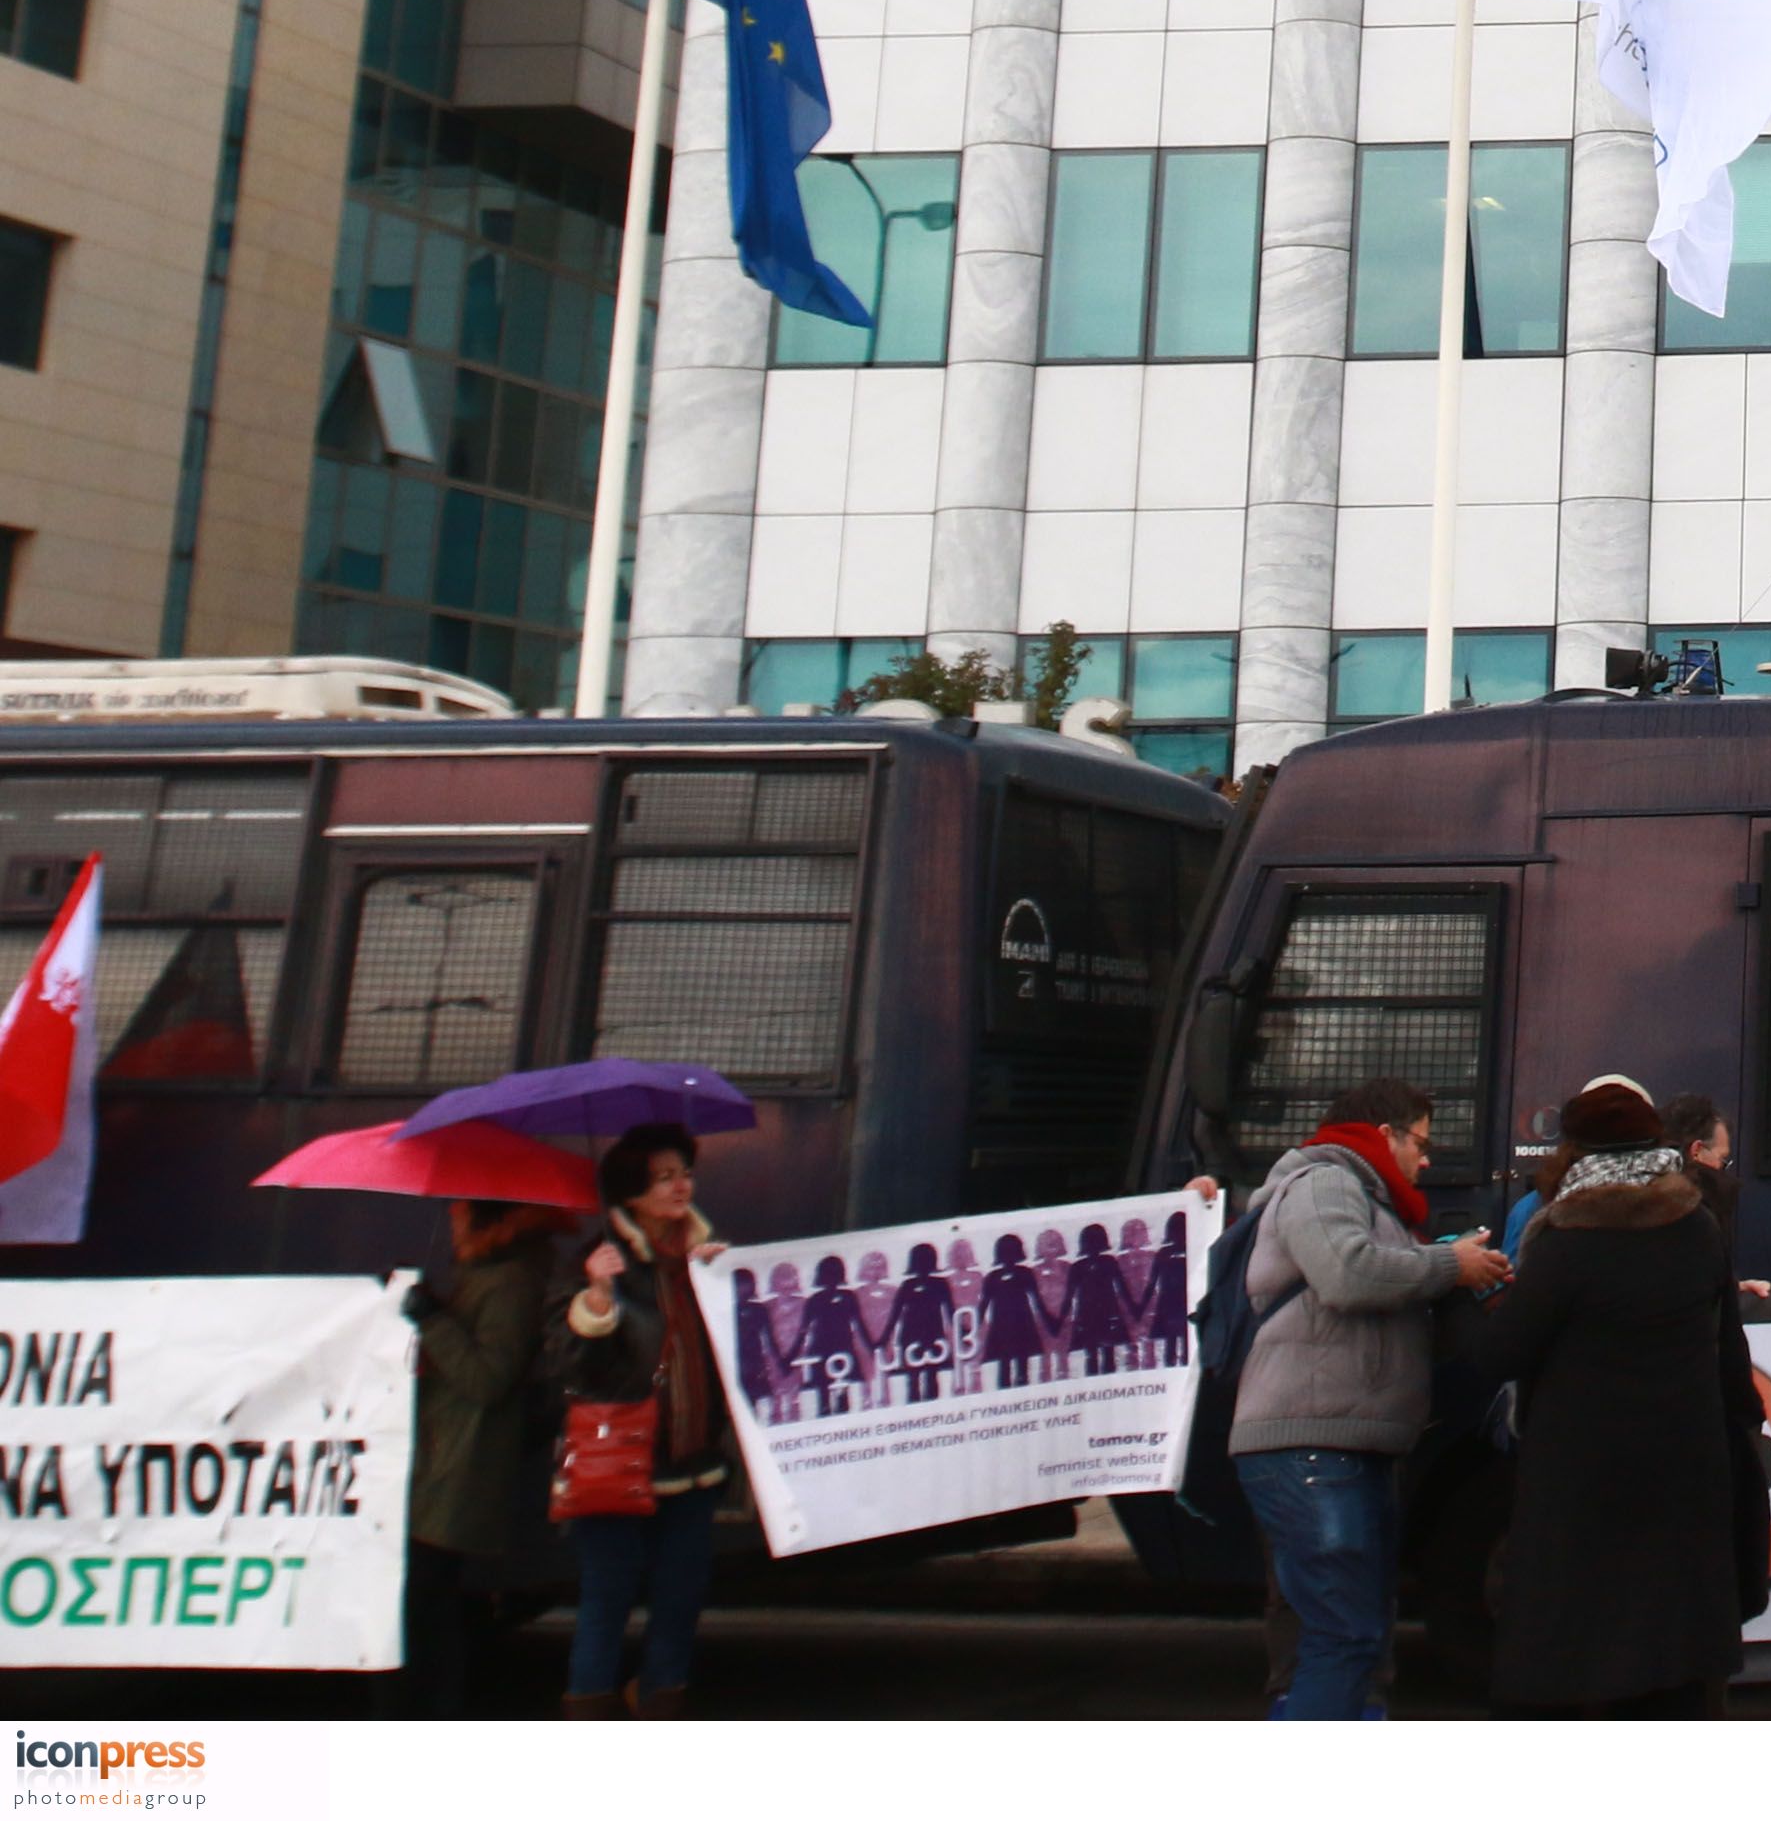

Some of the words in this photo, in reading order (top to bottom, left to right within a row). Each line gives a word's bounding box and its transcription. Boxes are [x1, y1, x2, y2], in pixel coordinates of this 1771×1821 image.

[1088, 1431, 1168, 1449] tomov.gr
[1037, 1457, 1103, 1477] feminist
[1106, 1451, 1168, 1469] website
